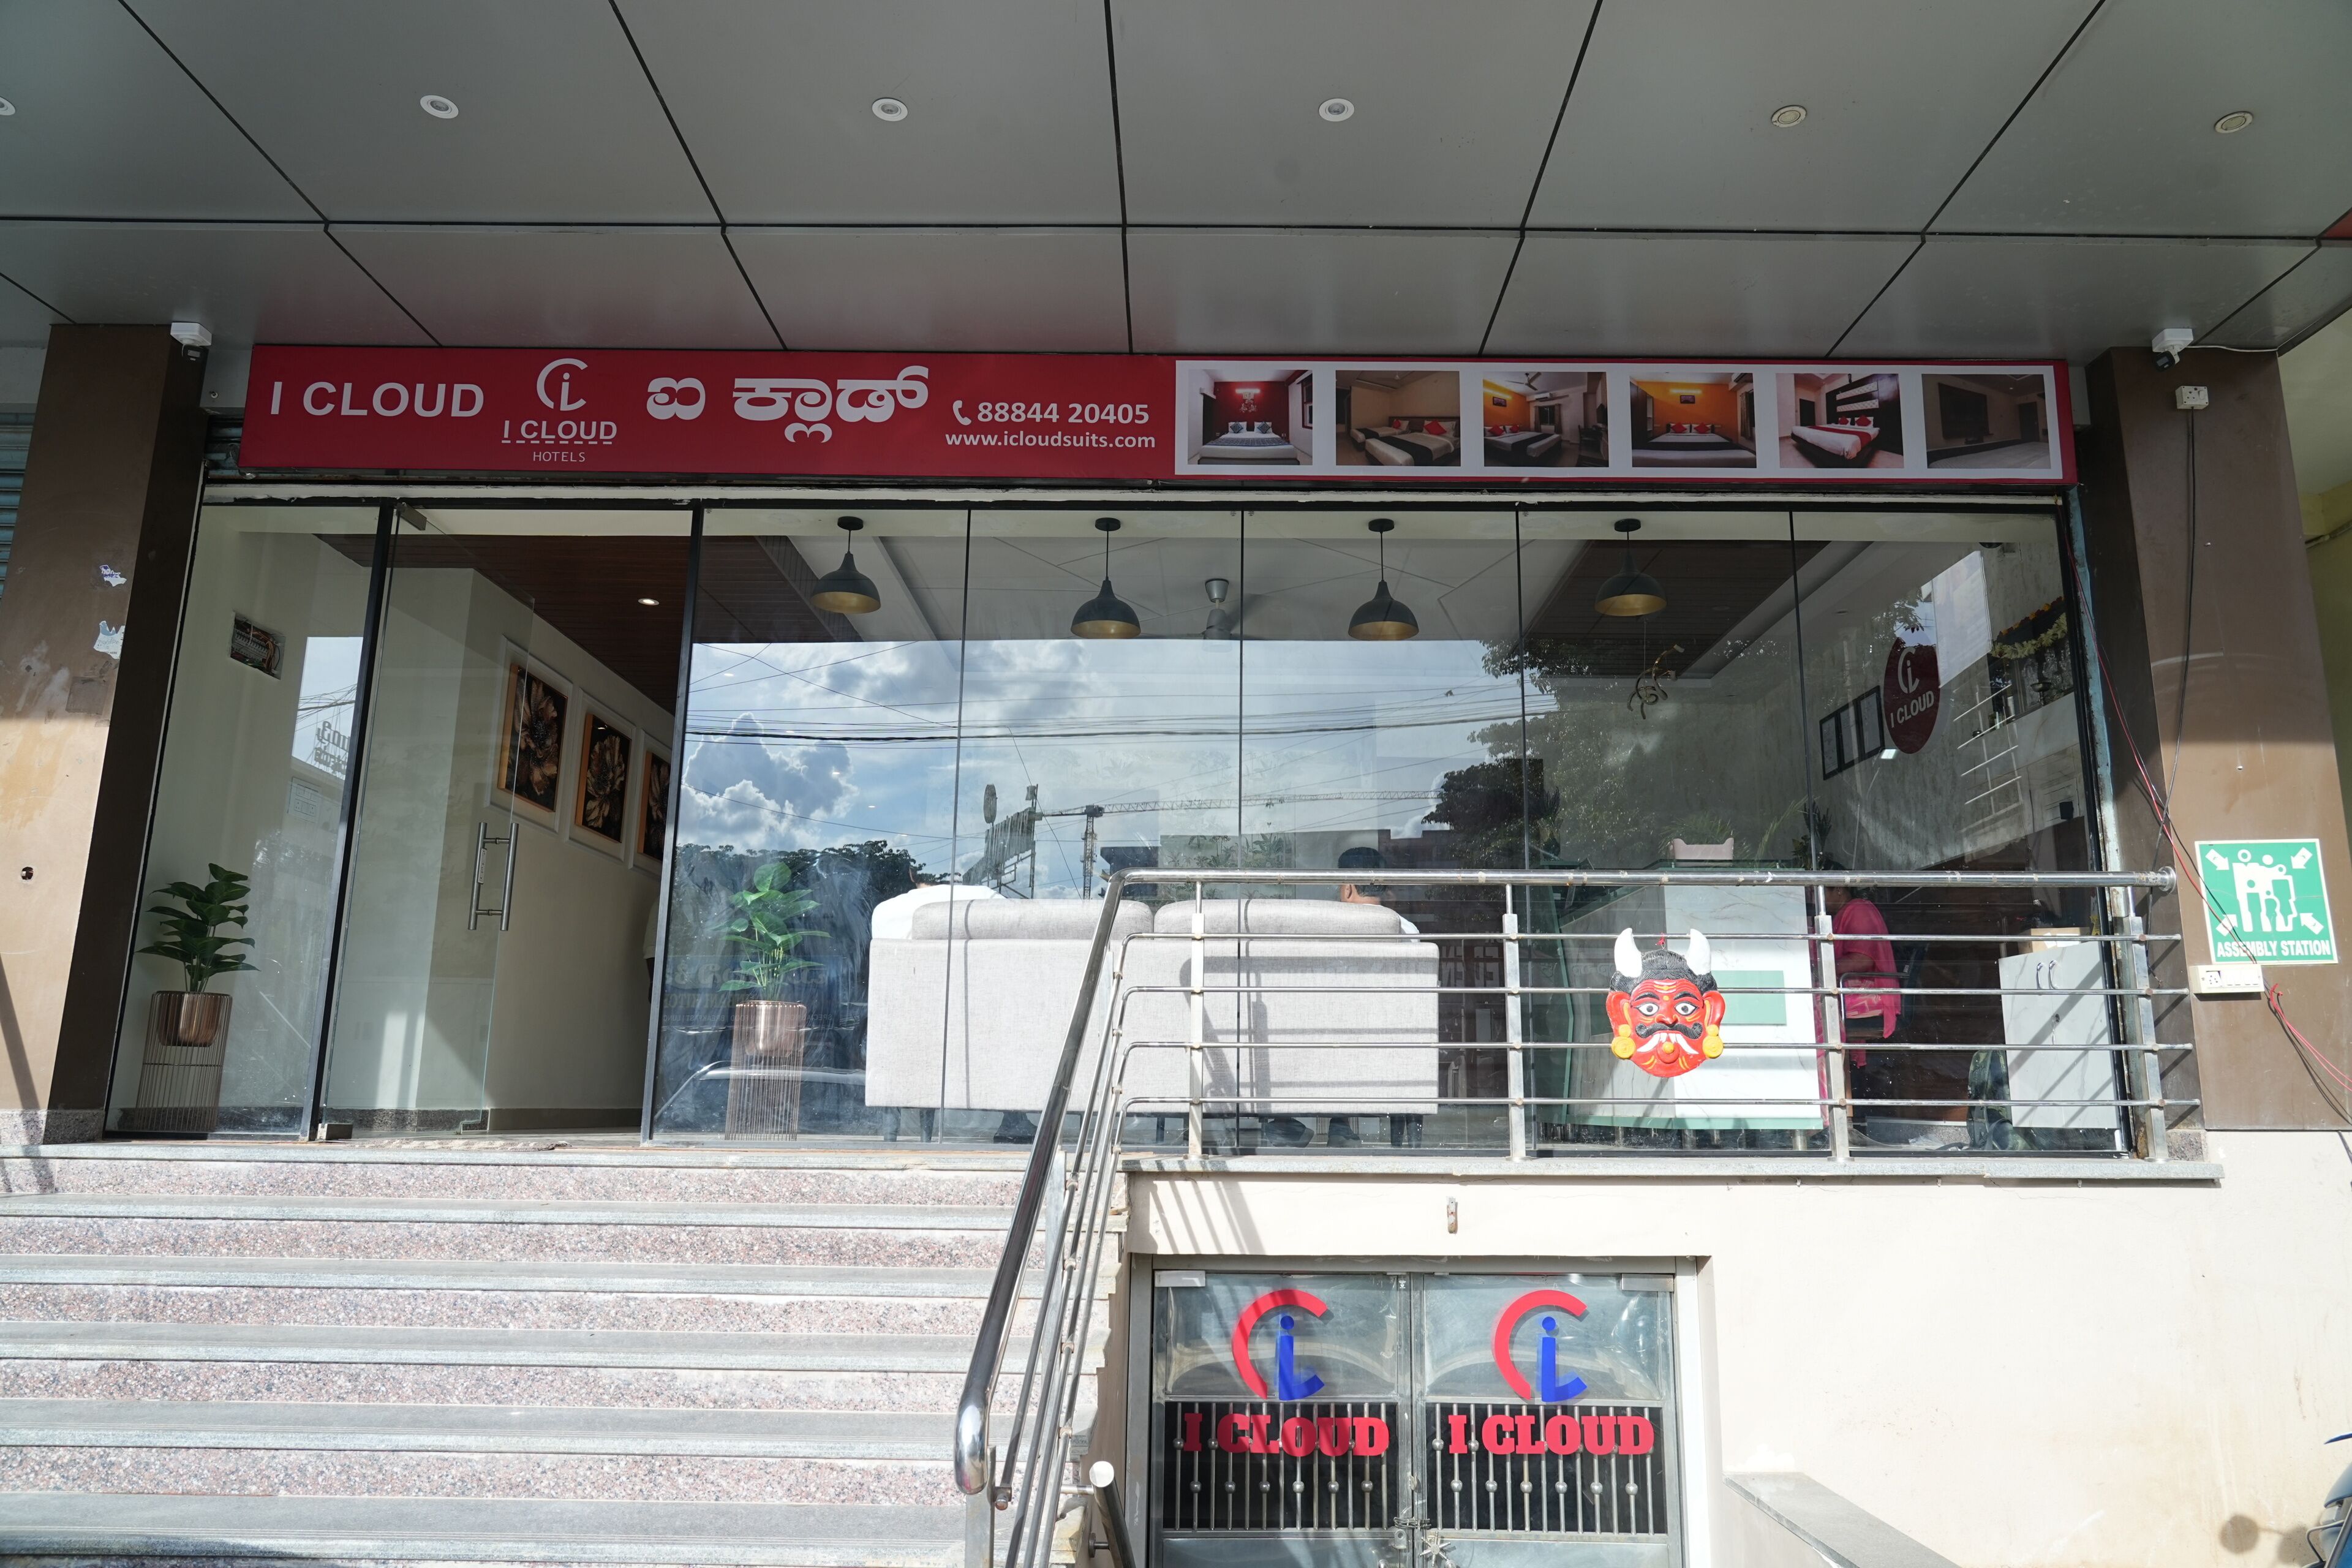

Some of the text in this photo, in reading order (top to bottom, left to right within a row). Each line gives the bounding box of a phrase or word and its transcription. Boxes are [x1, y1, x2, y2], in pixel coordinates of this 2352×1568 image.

[271, 382, 484, 418] I CLOUD
[646, 377, 706, 421] ಐ
[978, 402, 1150, 424] 88844 20405
[503, 420, 618, 440] I CLOUD
[945, 431, 1156, 448] www.icloudsuits.com
[533, 451, 586, 463] HOTELS
[1890, 712, 1894, 728] I
[1896, 690, 1934, 724] CLOUD
[2217, 940, 2332, 957] ASSEMBLY STATION
[1184, 1413, 1389, 1457] I CLOUD
[1448, 1414, 1654, 1455] I CLOUD
